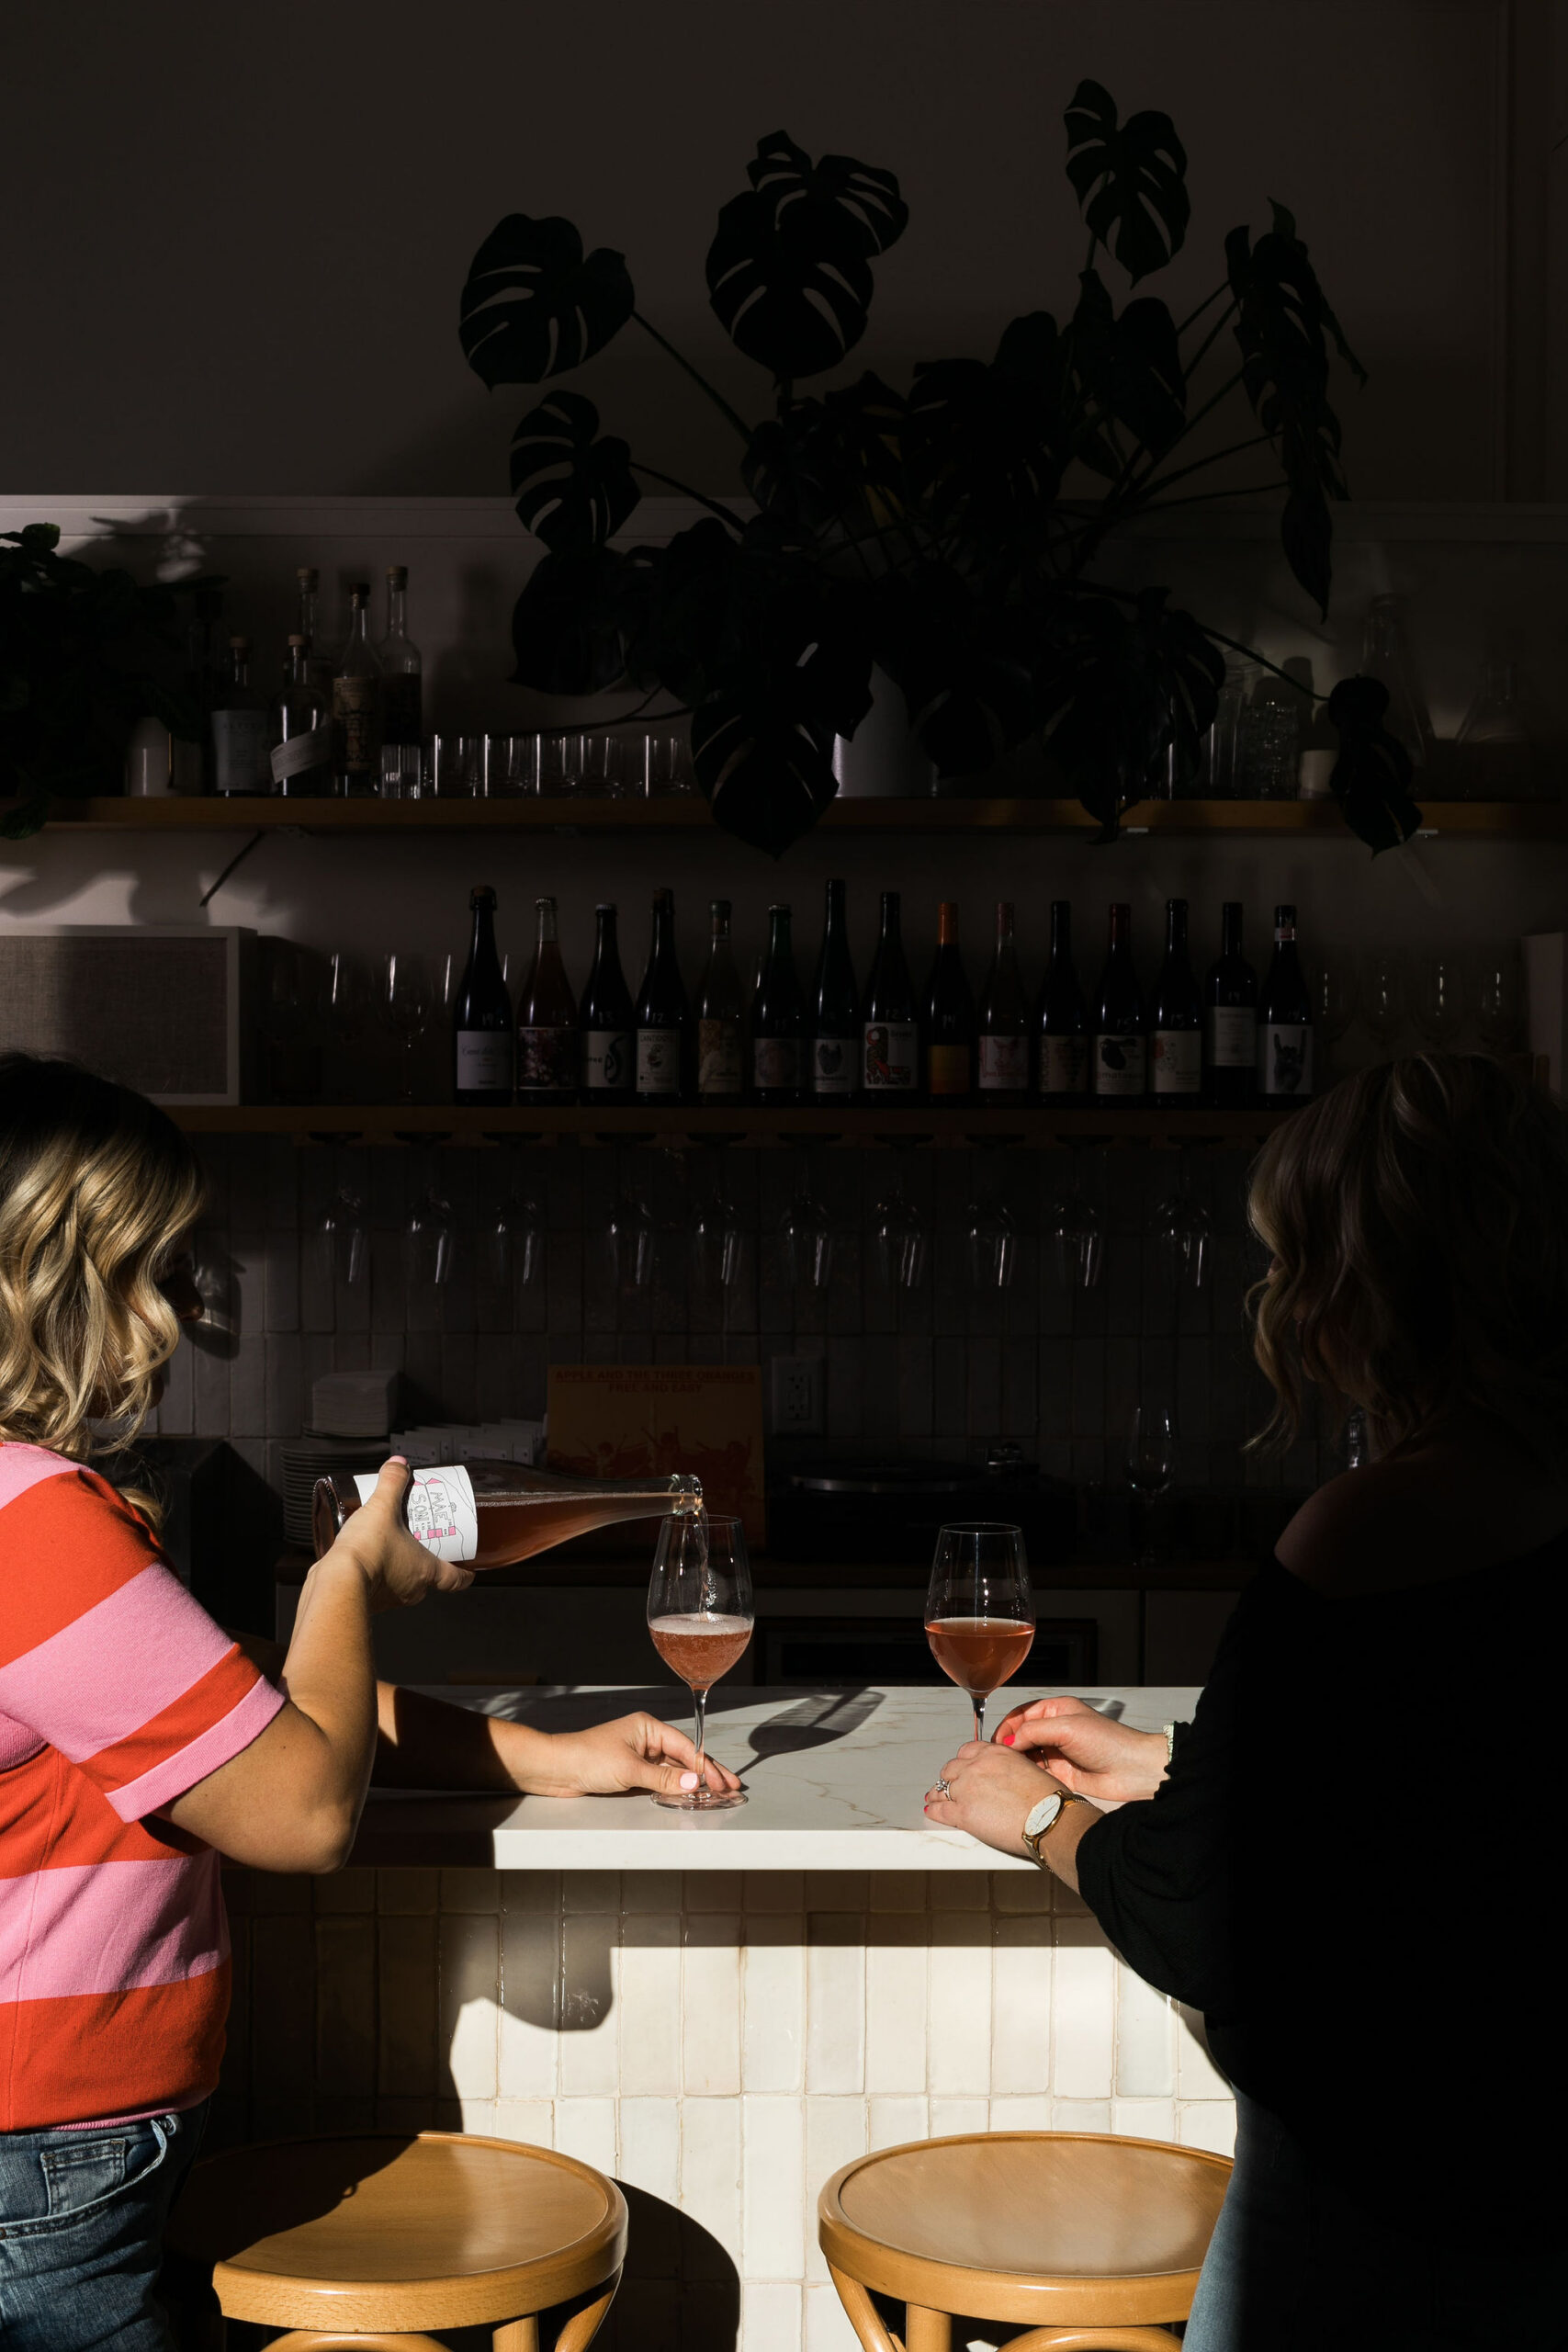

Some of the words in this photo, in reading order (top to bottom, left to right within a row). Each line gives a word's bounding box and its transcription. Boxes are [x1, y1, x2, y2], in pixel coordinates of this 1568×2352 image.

[651, 1012, 668, 1023] 12
[556, 1370, 593, 1381] APPLE
[597, 1370, 623, 1381] AND
[627, 1370, 650, 1381] THE
[654, 1370, 692, 1381] THREE
[695, 1370, 755, 1383] ORANGES
[608, 1383, 639, 1393] FREE
[642, 1383, 668, 1393] AND
[671, 1383, 704, 1393] EASY
